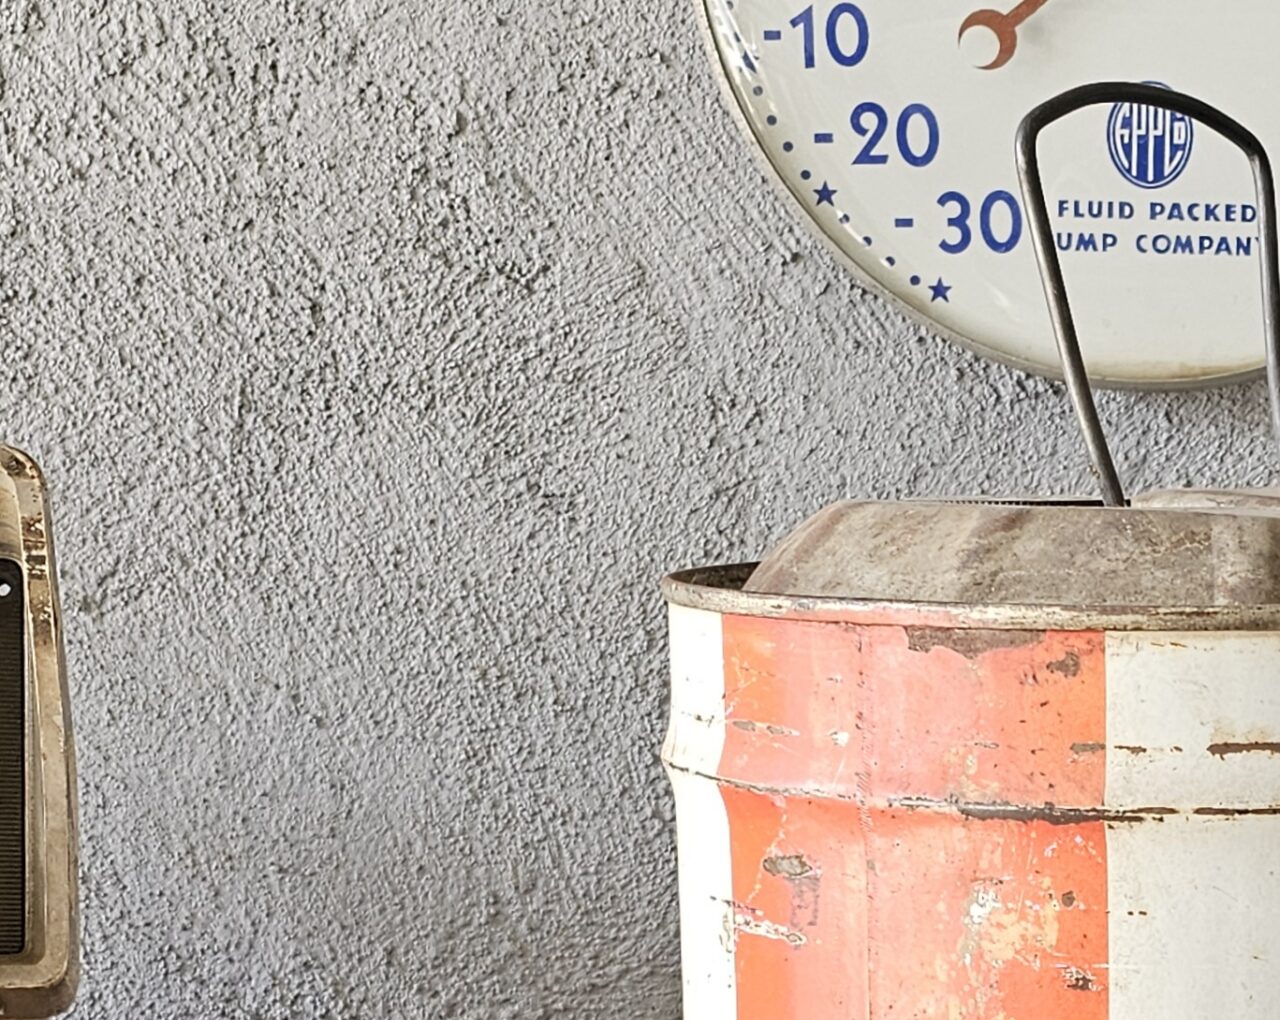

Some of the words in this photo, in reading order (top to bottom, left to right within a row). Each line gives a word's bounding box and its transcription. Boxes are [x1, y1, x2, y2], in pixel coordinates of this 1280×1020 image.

[1057, 199, 1135, 219] FLUID
[1149, 202, 1257, 223] PACKED
[1056, 232, 1118, 252] UMP
[1136, 234, 1260, 257] COMPAN
